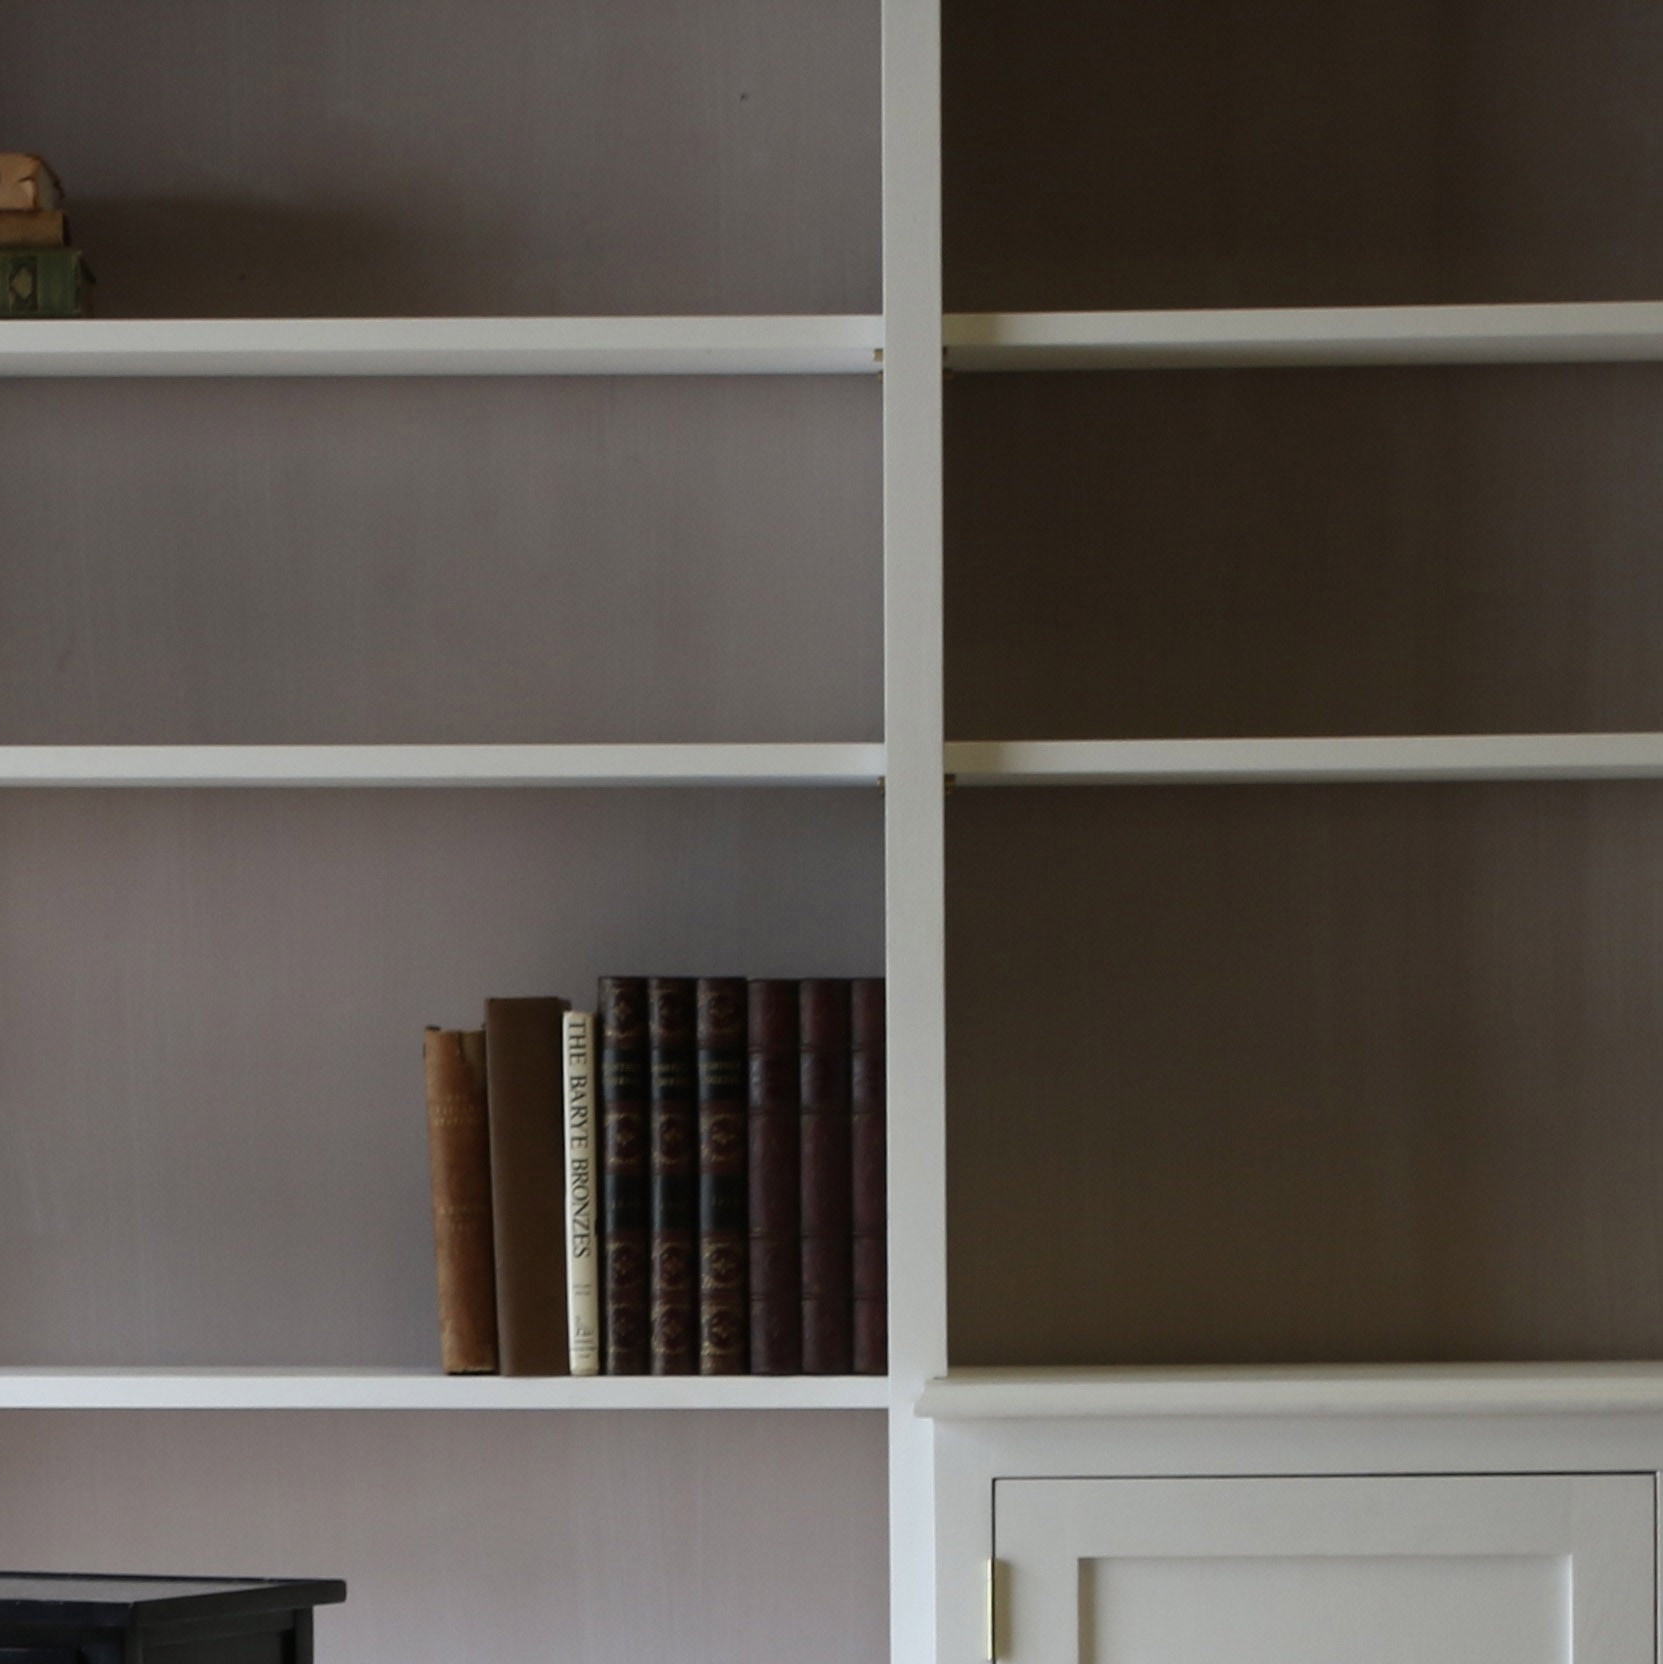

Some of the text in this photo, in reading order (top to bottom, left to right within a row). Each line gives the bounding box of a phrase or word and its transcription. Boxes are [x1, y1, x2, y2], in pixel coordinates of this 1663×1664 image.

[568, 1018, 592, 1258] THE BARYE BRONZES
